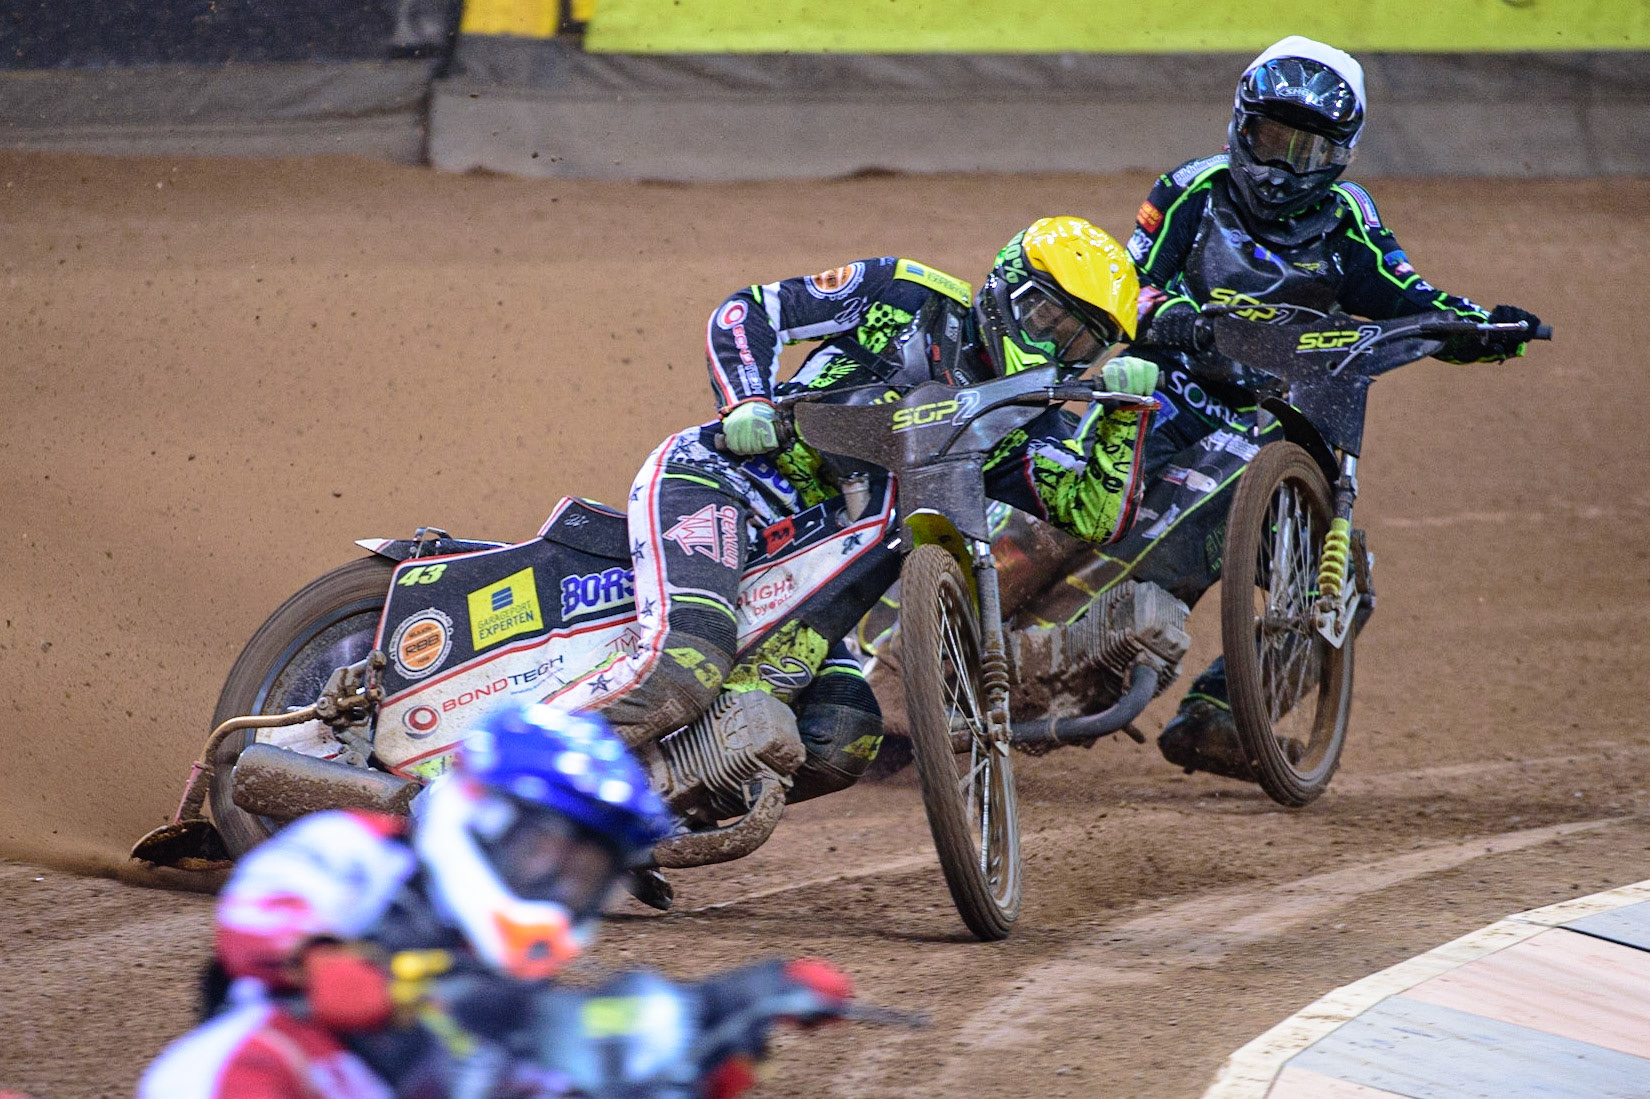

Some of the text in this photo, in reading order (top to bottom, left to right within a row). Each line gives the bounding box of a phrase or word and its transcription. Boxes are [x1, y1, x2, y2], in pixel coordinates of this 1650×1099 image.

[397, 563, 448, 586] 43
[478, 600, 531, 628] GARAGEPORT
[480, 610, 534, 640] EXPERTEN
[442, 655, 564, 713] BONDTECH
